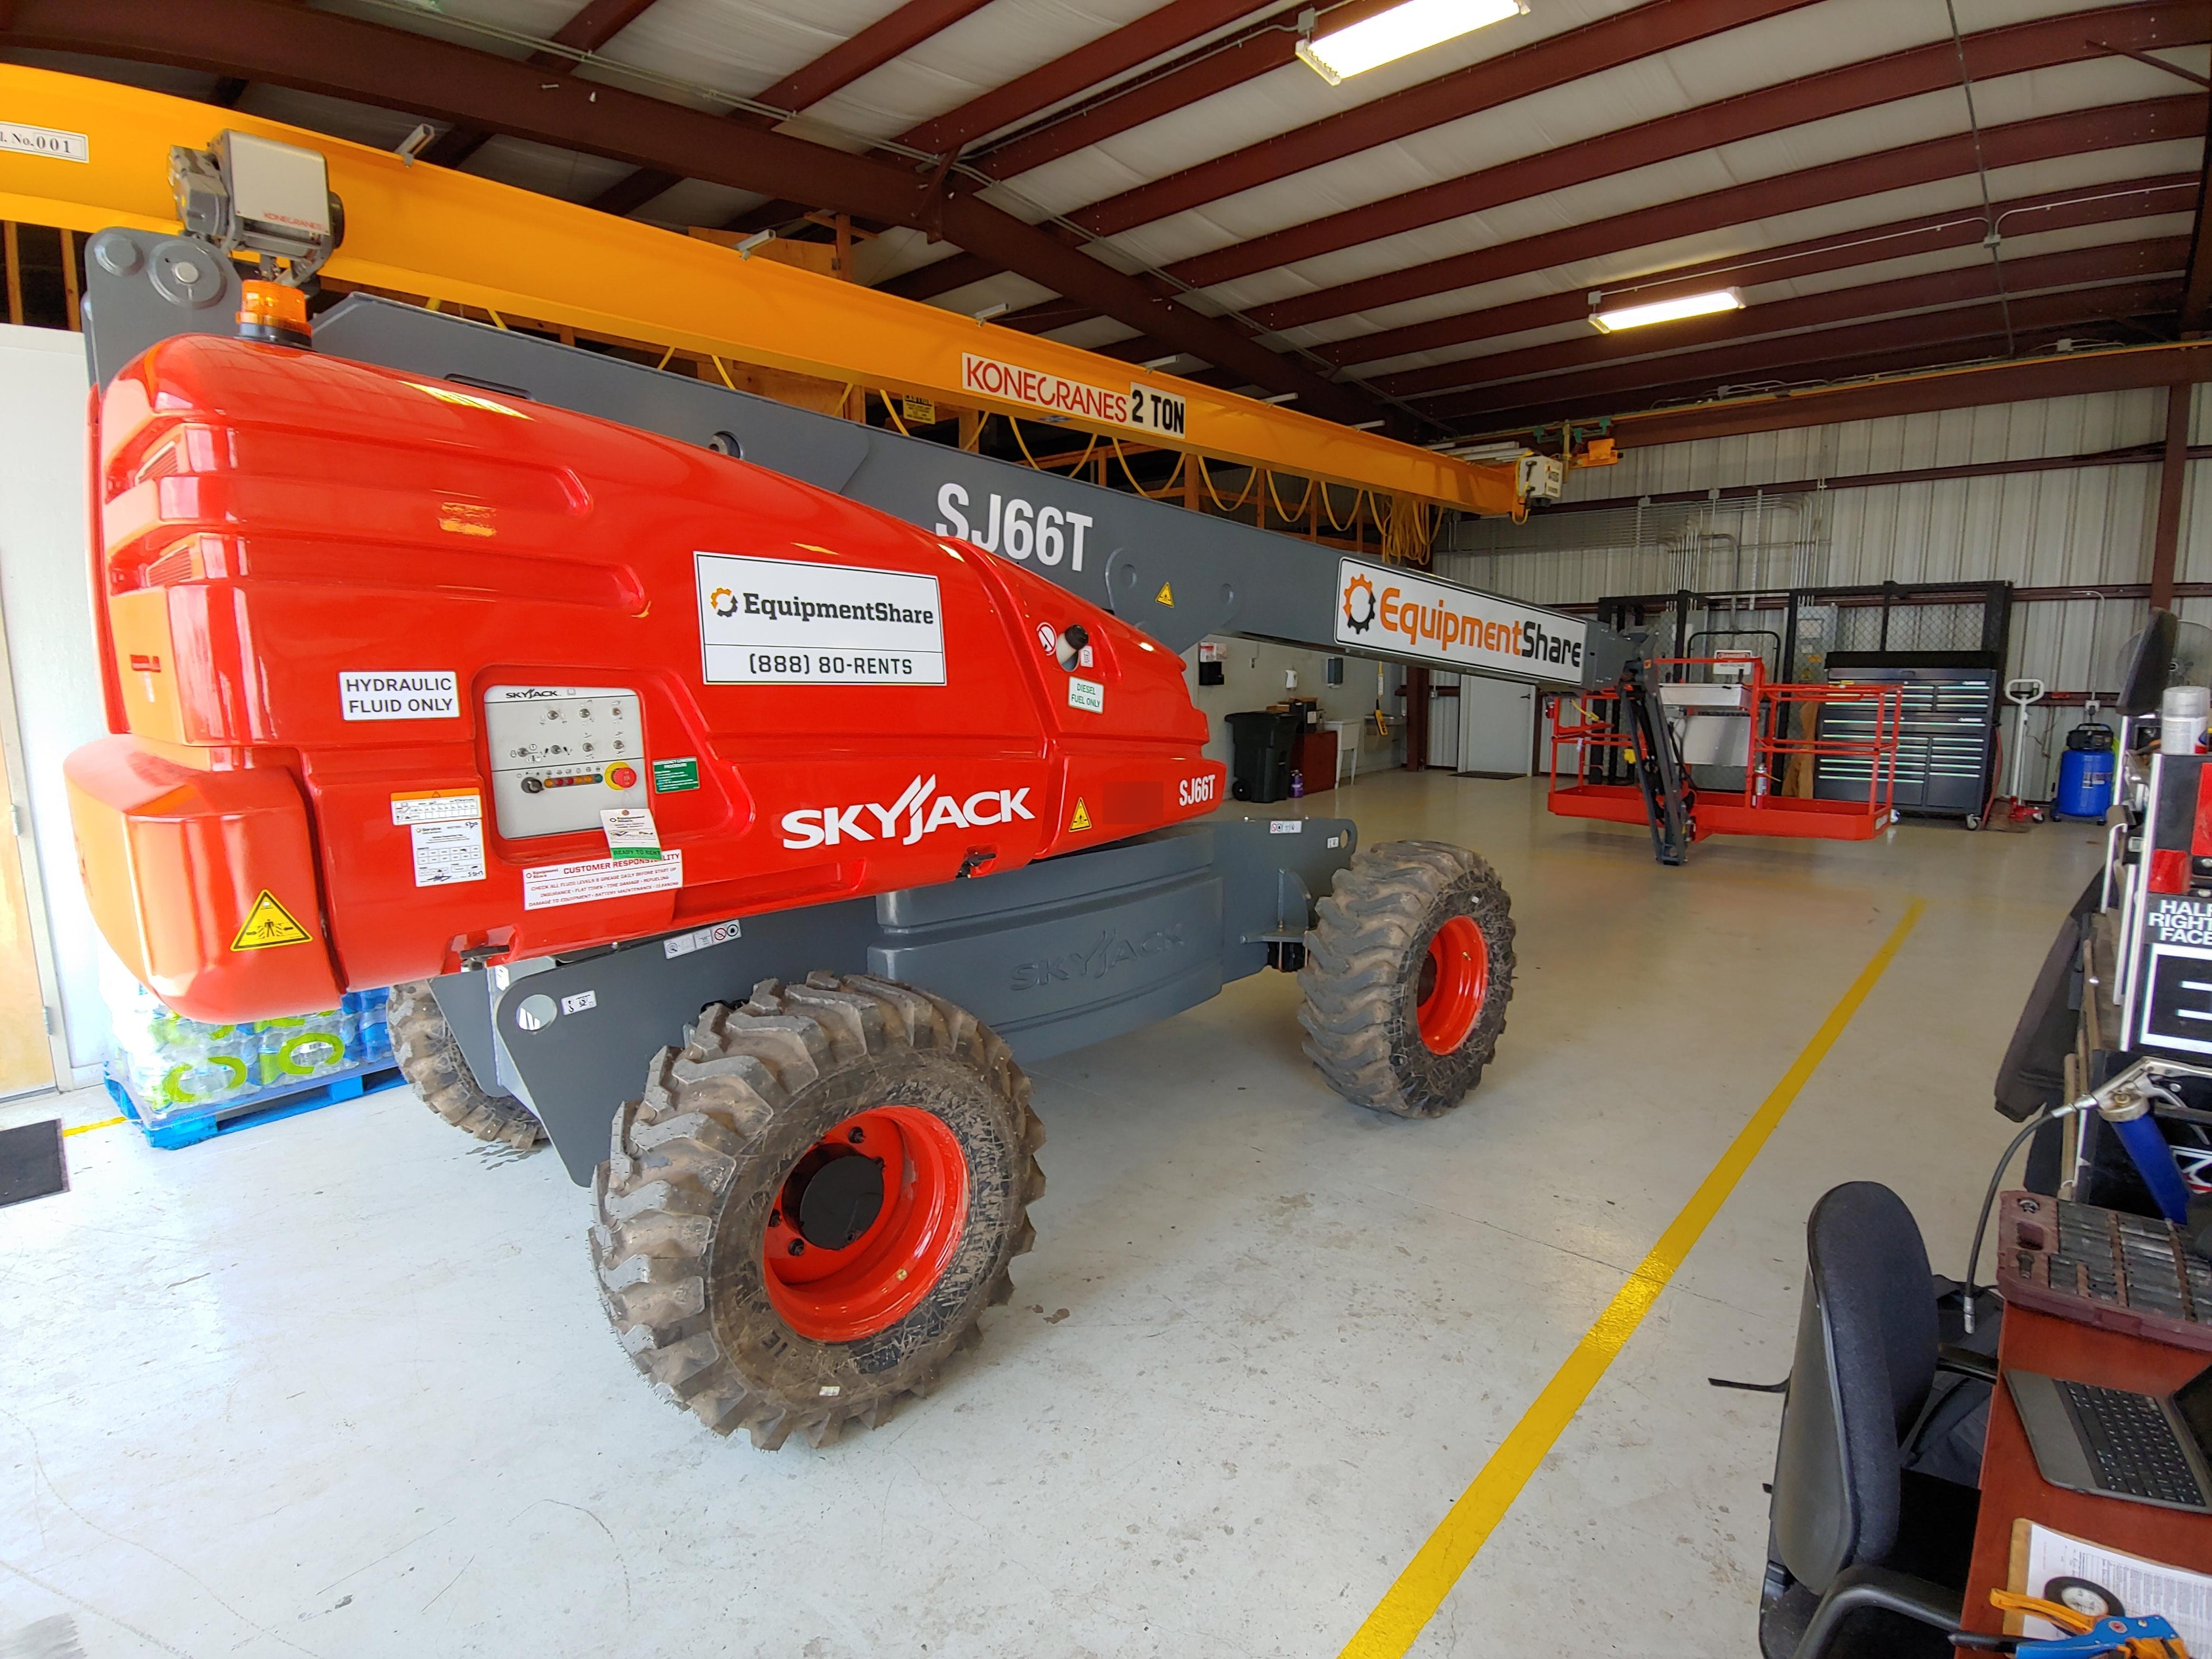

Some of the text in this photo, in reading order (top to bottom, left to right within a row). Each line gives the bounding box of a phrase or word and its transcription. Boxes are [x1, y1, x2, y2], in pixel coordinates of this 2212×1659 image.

[967, 357, 1127, 423] KONECRANES
[1132, 389, 1184, 434] 2 TON
[935, 483, 1093, 571] SJ66T
[743, 593, 934, 624] EquipmentShare
[1380, 588, 1581, 667] EquipmentShare
[750, 653, 912, 675] (888) 80-RENTS
[346, 678, 451, 692] HYDRAULIC
[505, 689, 558, 699] SKYJACK
[1077, 683, 1096, 695] DIESEL
[349, 698, 453, 713] FLUID ONLY
[1071, 694, 1100, 707] FUEL ONLY
[1179, 774, 1216, 806] SJ66T
[781, 774, 1036, 849] SKYJACK
[564, 862, 610, 874] CUSTOMER
[2149, 912, 2212, 931] RIGHT
[2160, 927, 2212, 945] FACE
[1011, 923, 1184, 991] SKYJACK
